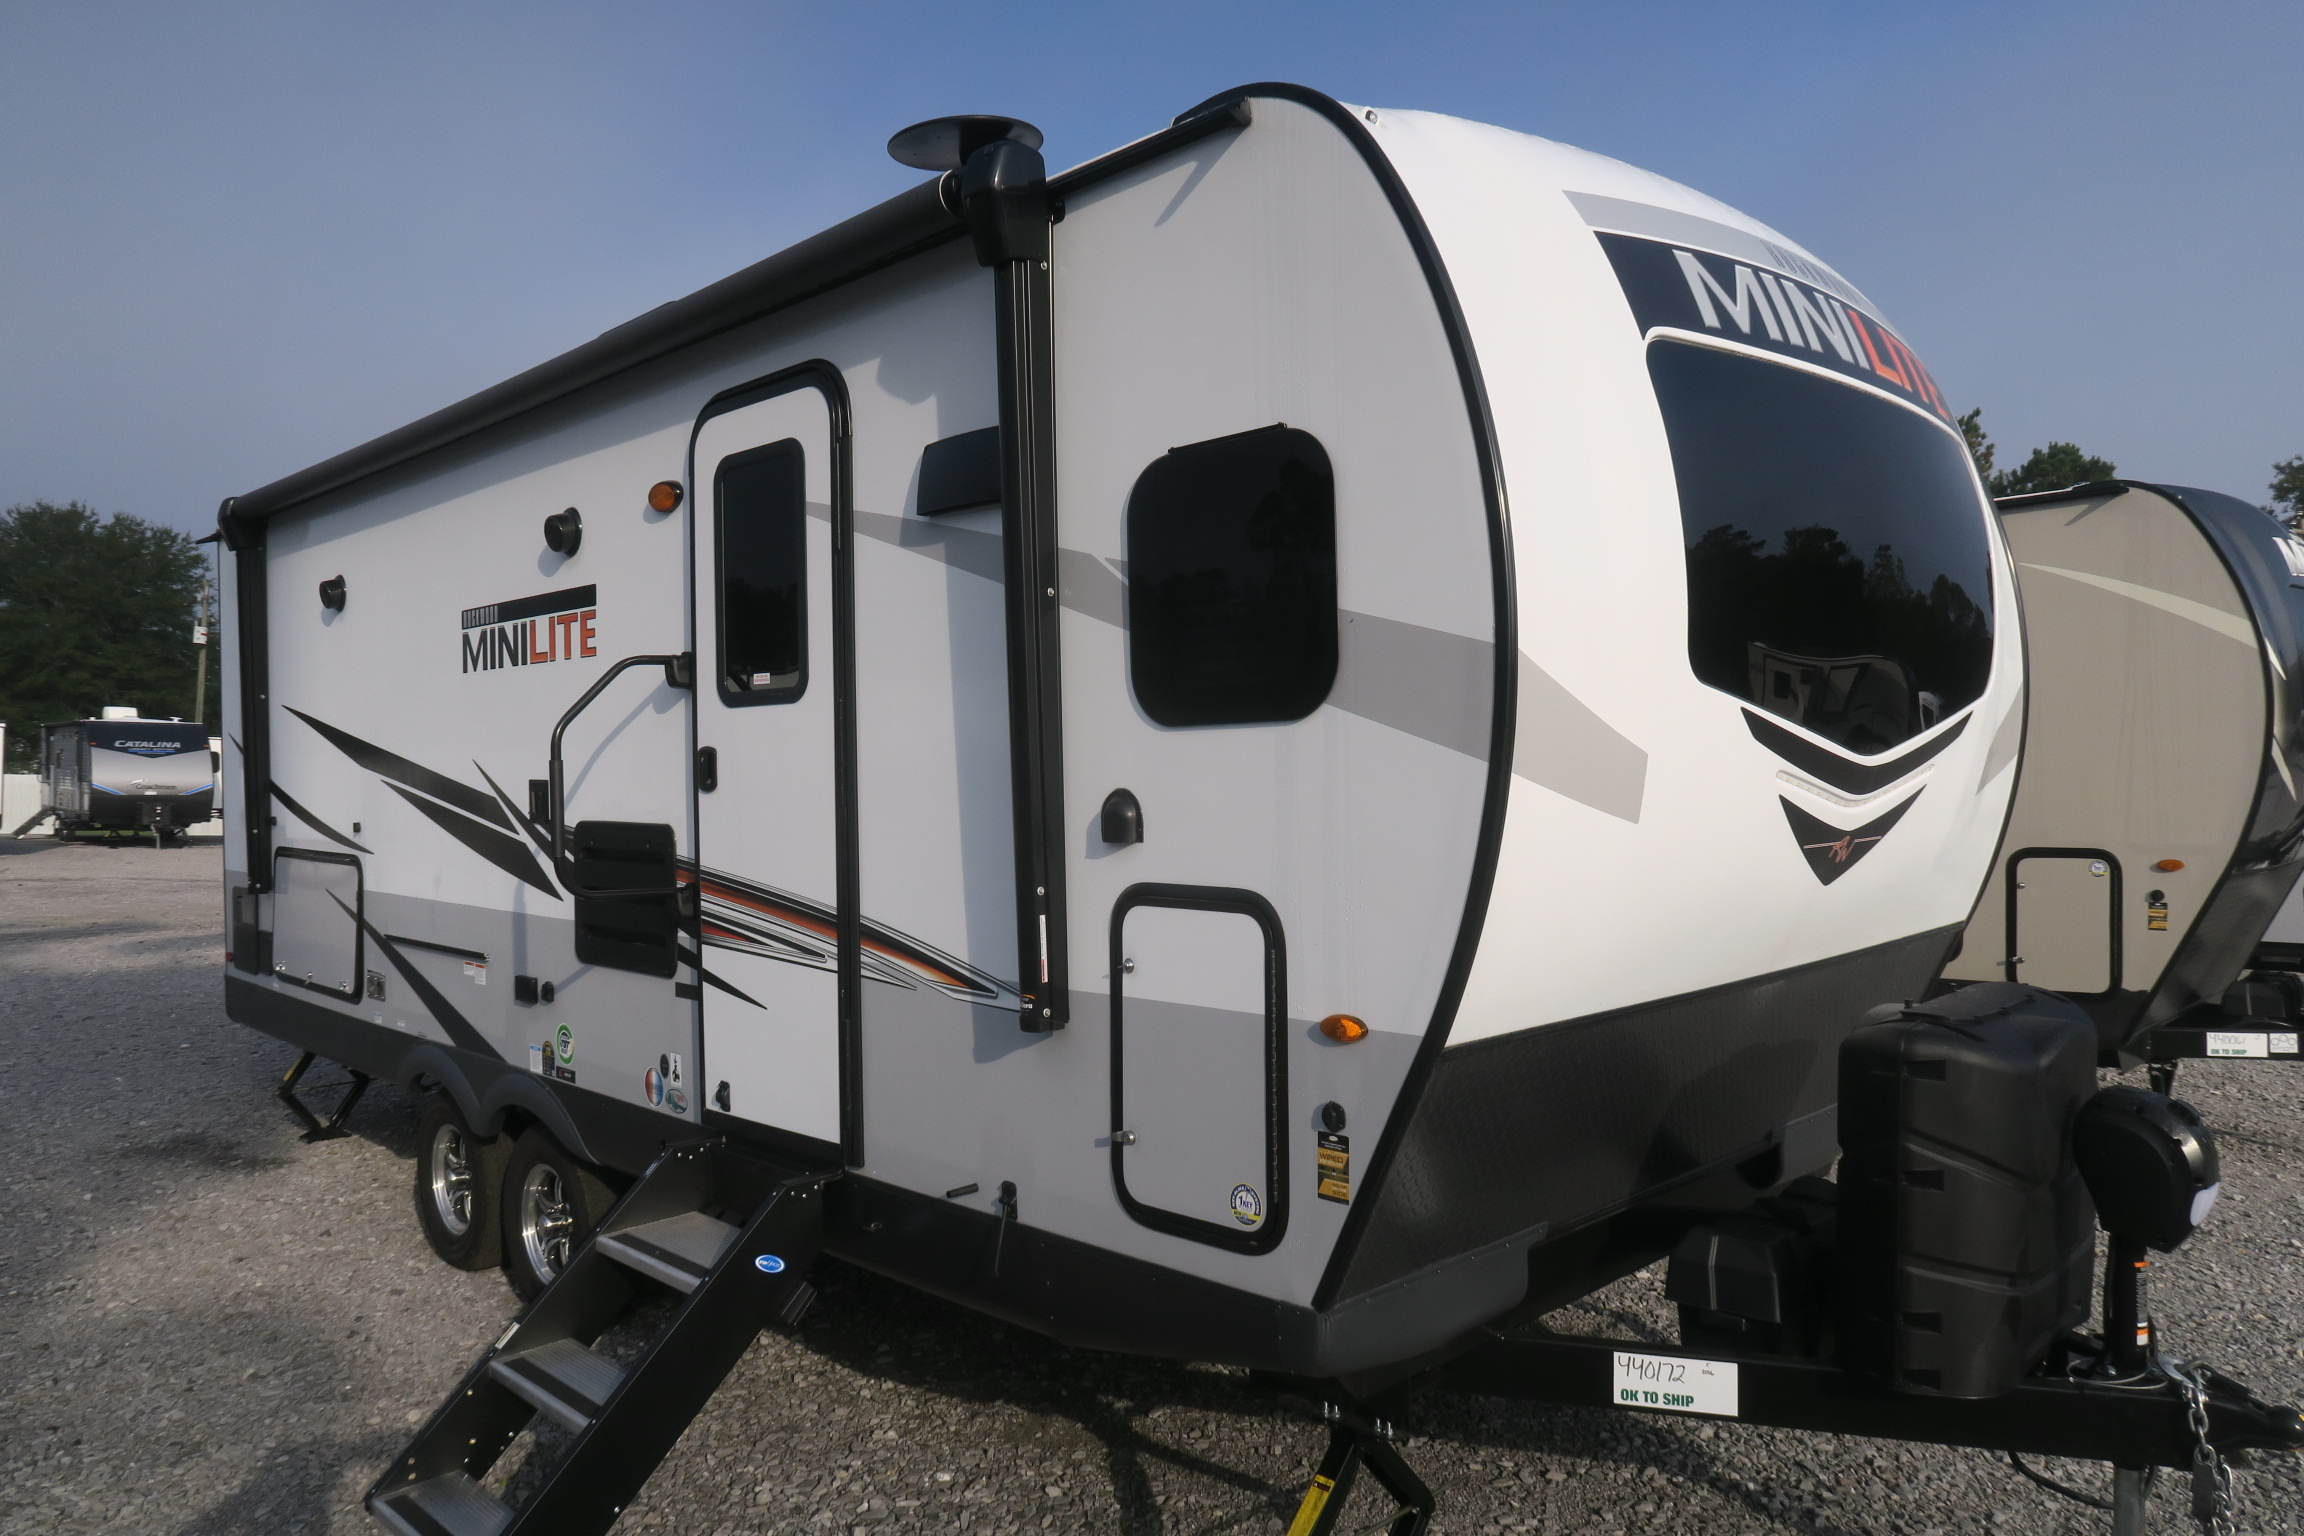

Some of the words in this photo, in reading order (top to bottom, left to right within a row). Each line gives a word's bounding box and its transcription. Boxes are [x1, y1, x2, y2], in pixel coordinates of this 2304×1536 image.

[462, 609, 597, 674] MINILITE
[114, 740, 181, 748] CATALINA
[1319, 1152, 1344, 1163] WIRED
[1618, 1355, 1687, 1383] 440172
[1621, 1389, 1639, 1402] OK
[1643, 1391, 1658, 1403] TO
[1663, 1393, 1694, 1407] SHIP
